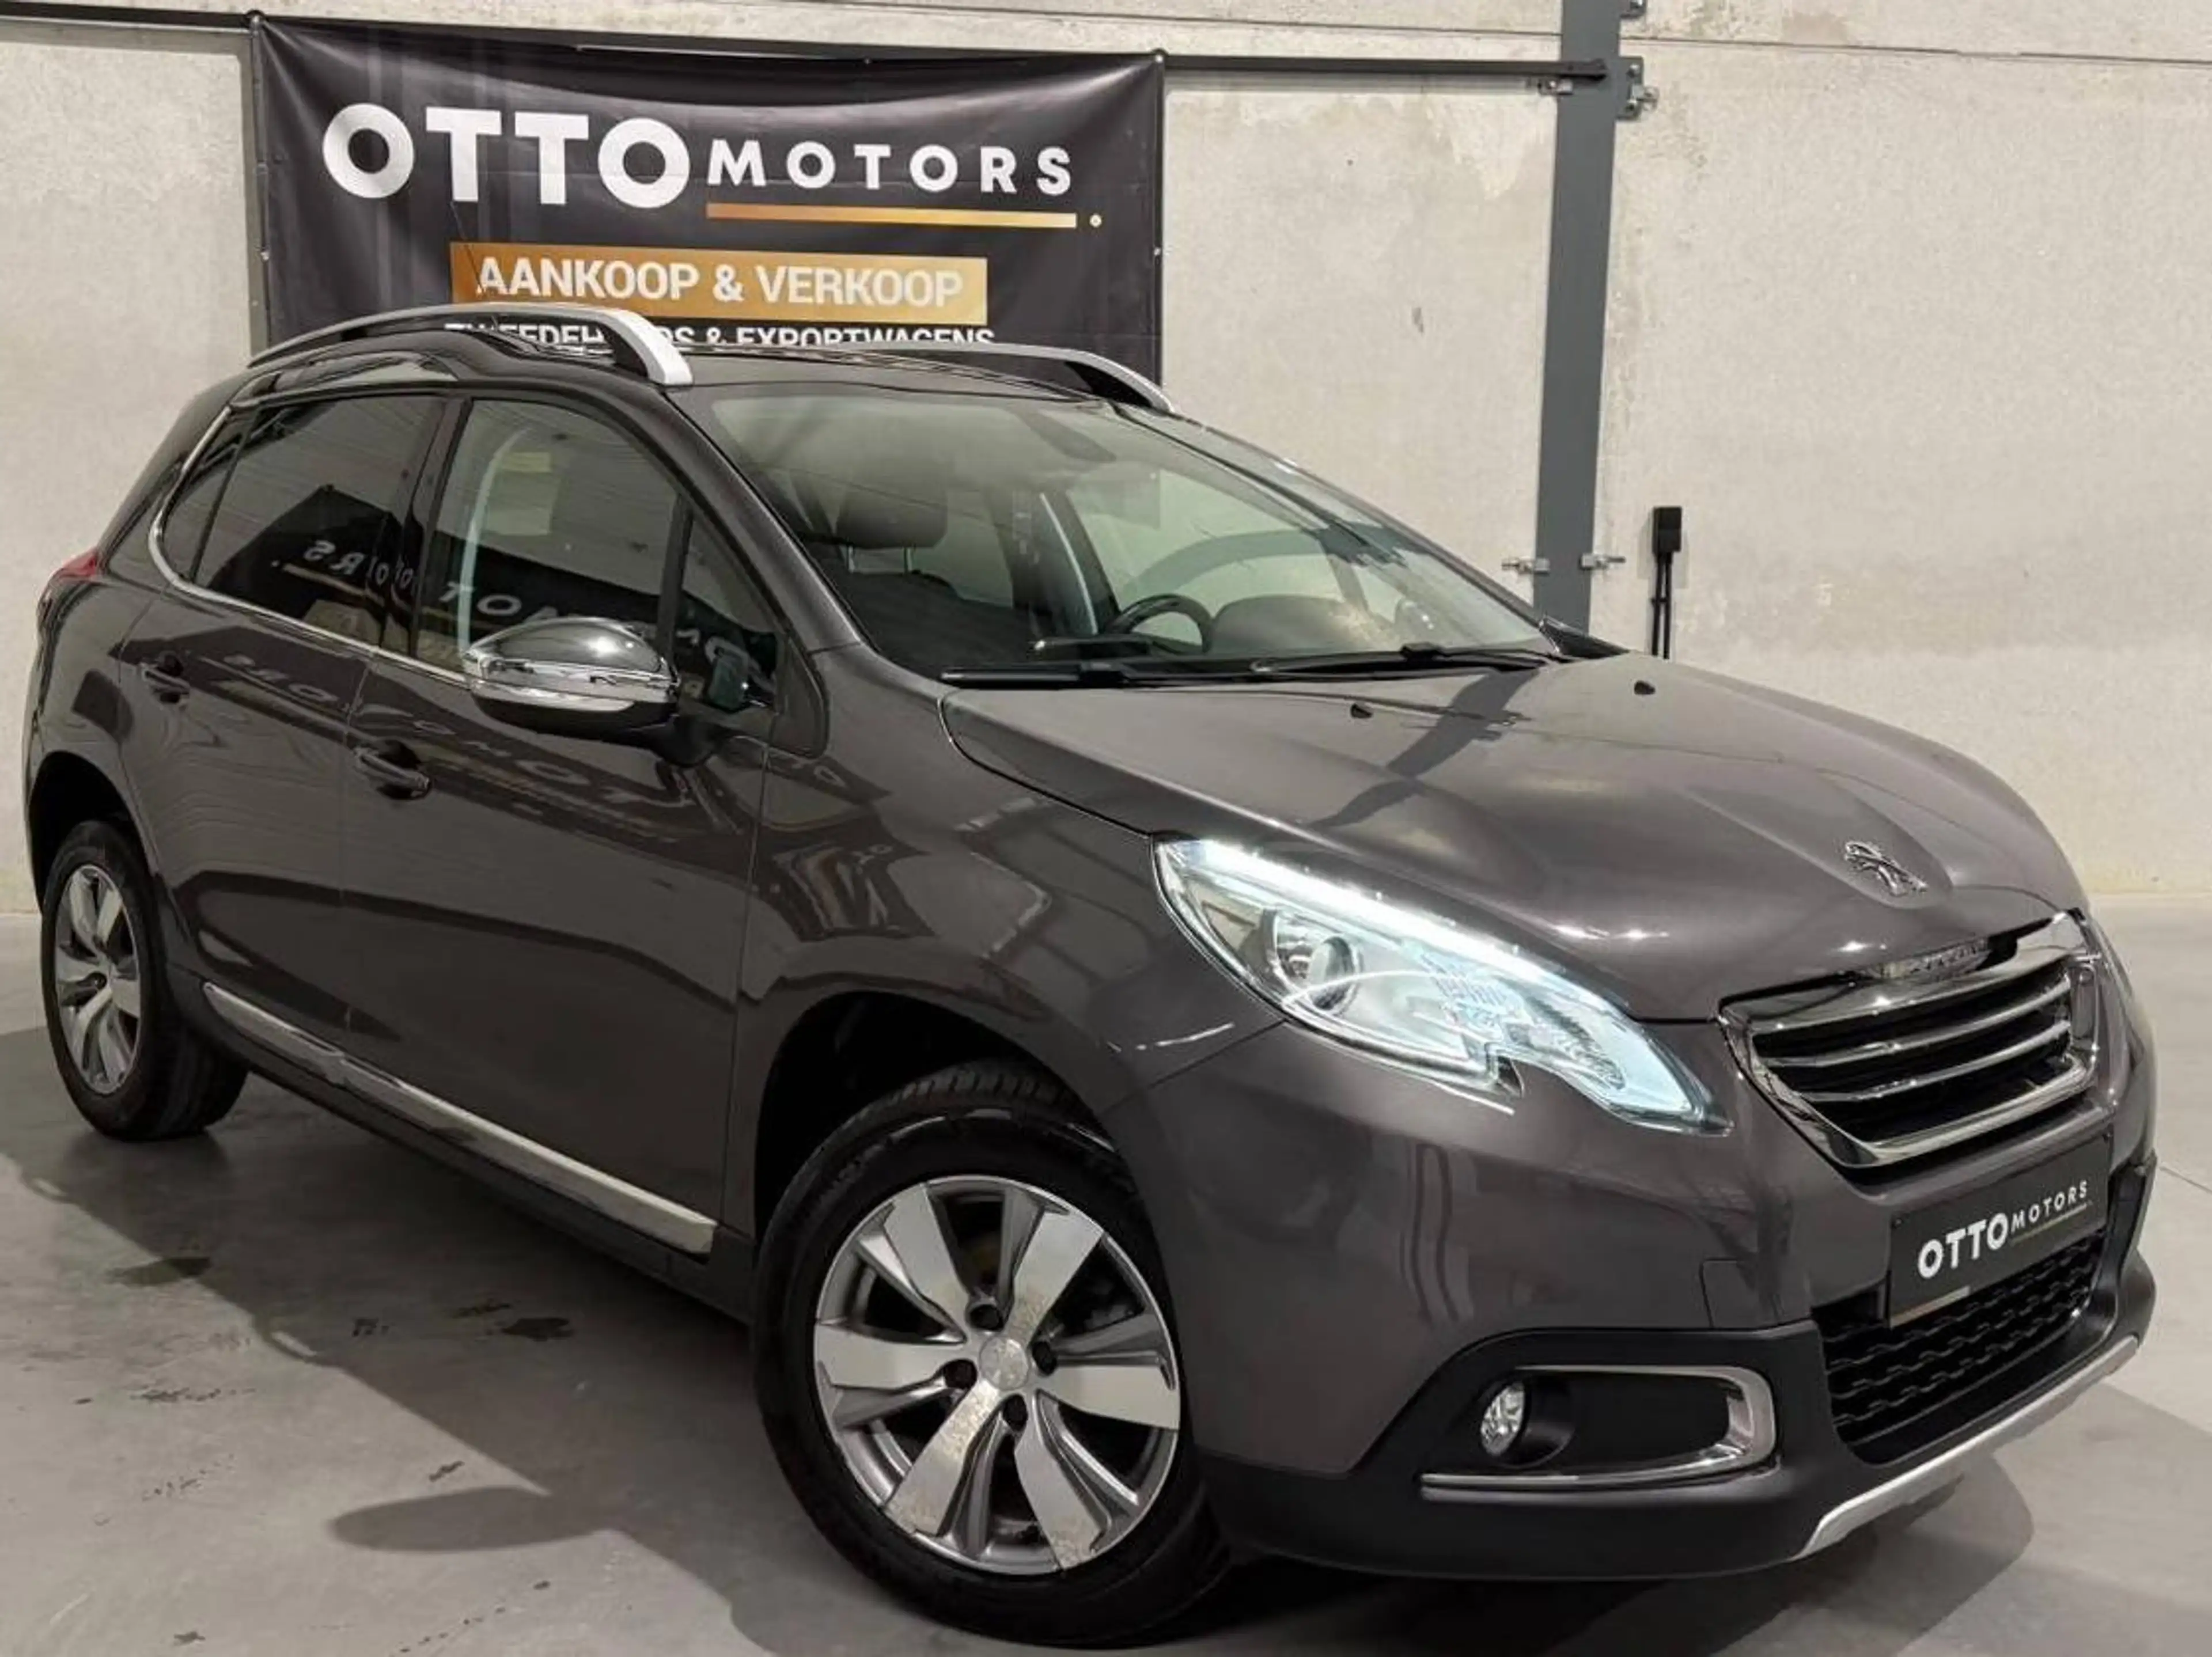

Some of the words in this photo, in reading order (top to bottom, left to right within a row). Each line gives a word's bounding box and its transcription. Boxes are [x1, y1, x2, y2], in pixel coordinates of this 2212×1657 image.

[323, 103, 691, 208] OTTO
[707, 139, 1071, 196] MOTORS
[477, 257, 700, 301] AANKOOP
[712, 264, 744, 303] &
[753, 265, 964, 308] VERKOOP
[1917, 1212, 2009, 1279] OTTO
[2010, 1180, 2088, 1234] MOTORS
